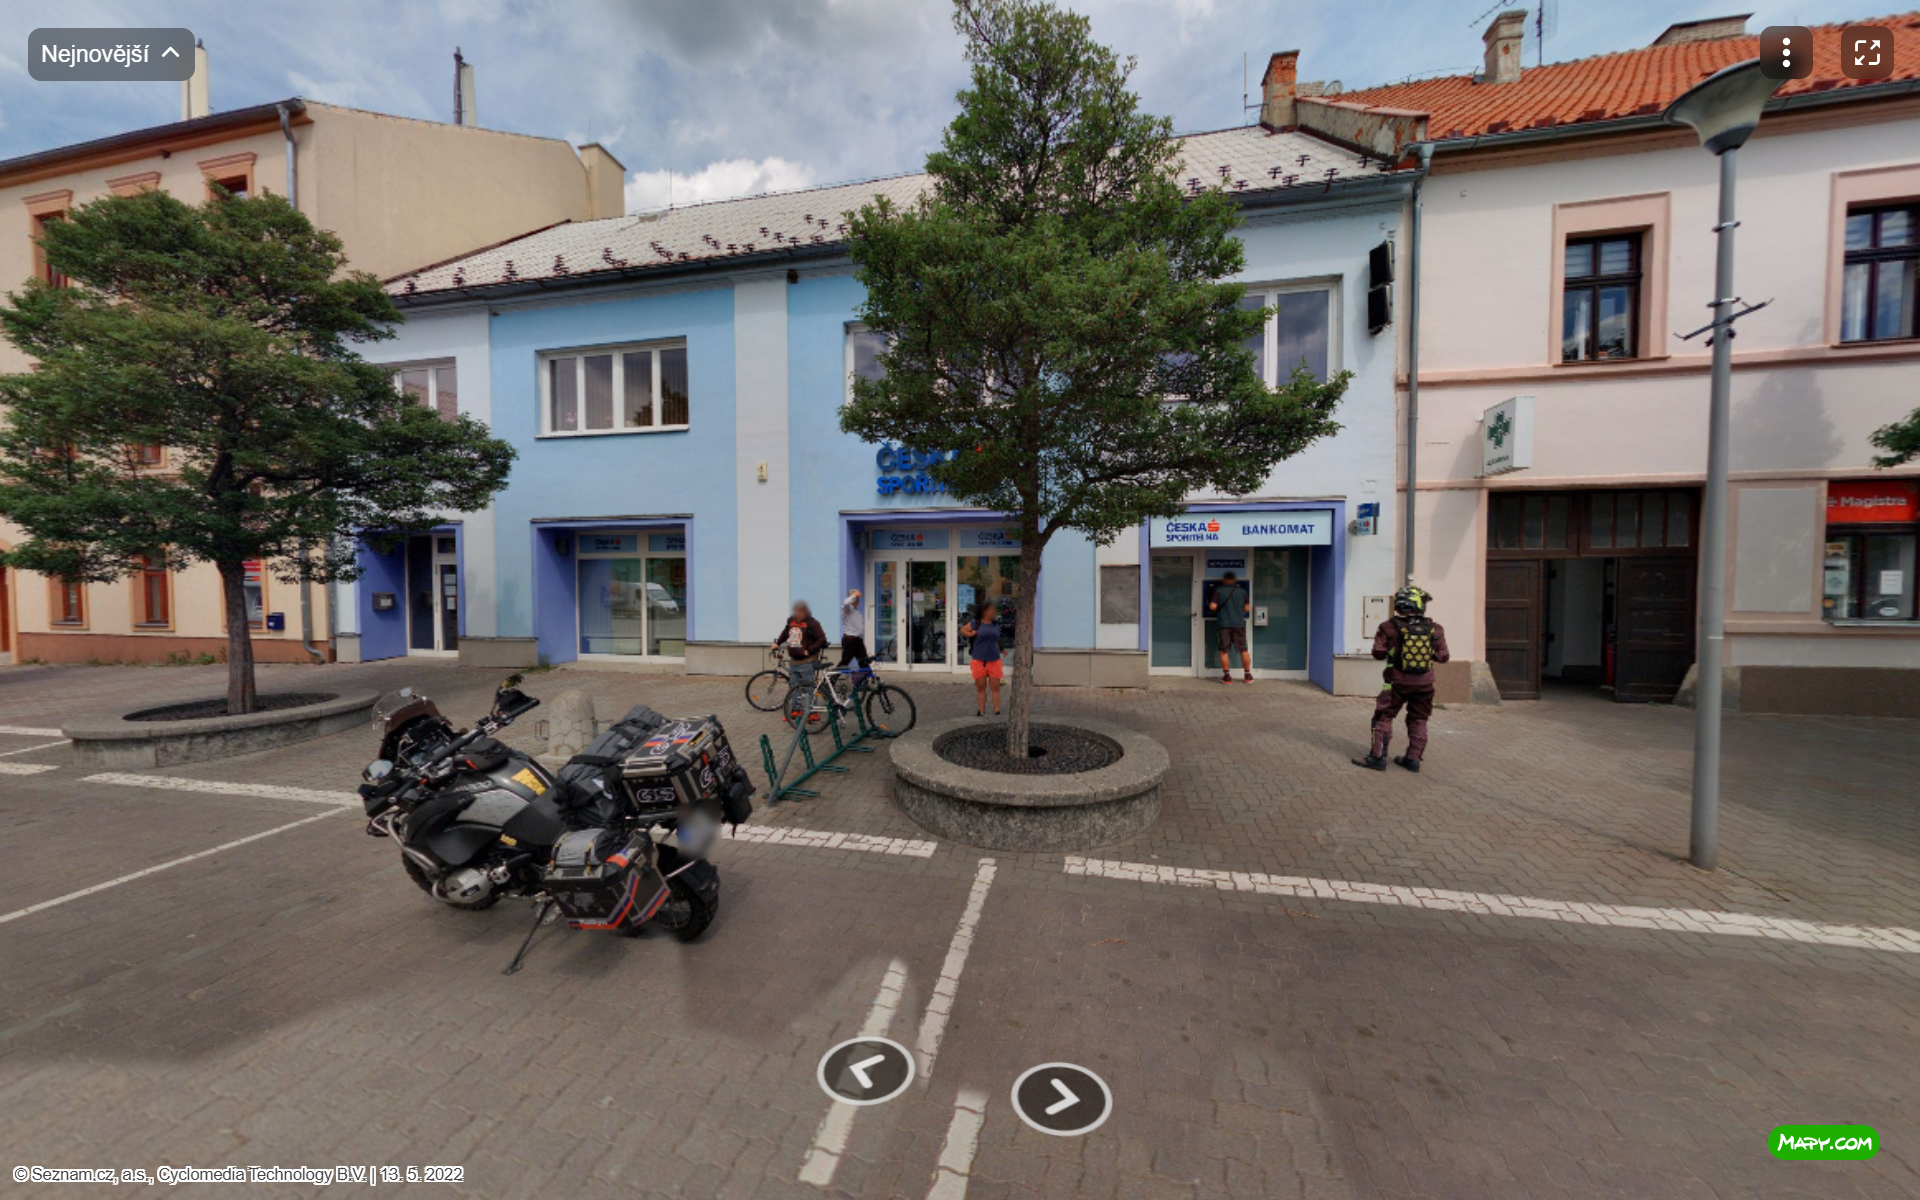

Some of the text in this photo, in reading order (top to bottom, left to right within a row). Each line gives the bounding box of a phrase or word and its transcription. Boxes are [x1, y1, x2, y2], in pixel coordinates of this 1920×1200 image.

[1840, 496, 1908, 508] Magistra
[1242, 524, 1315, 536] BANKOMAT
[636, 787, 676, 803] GS
